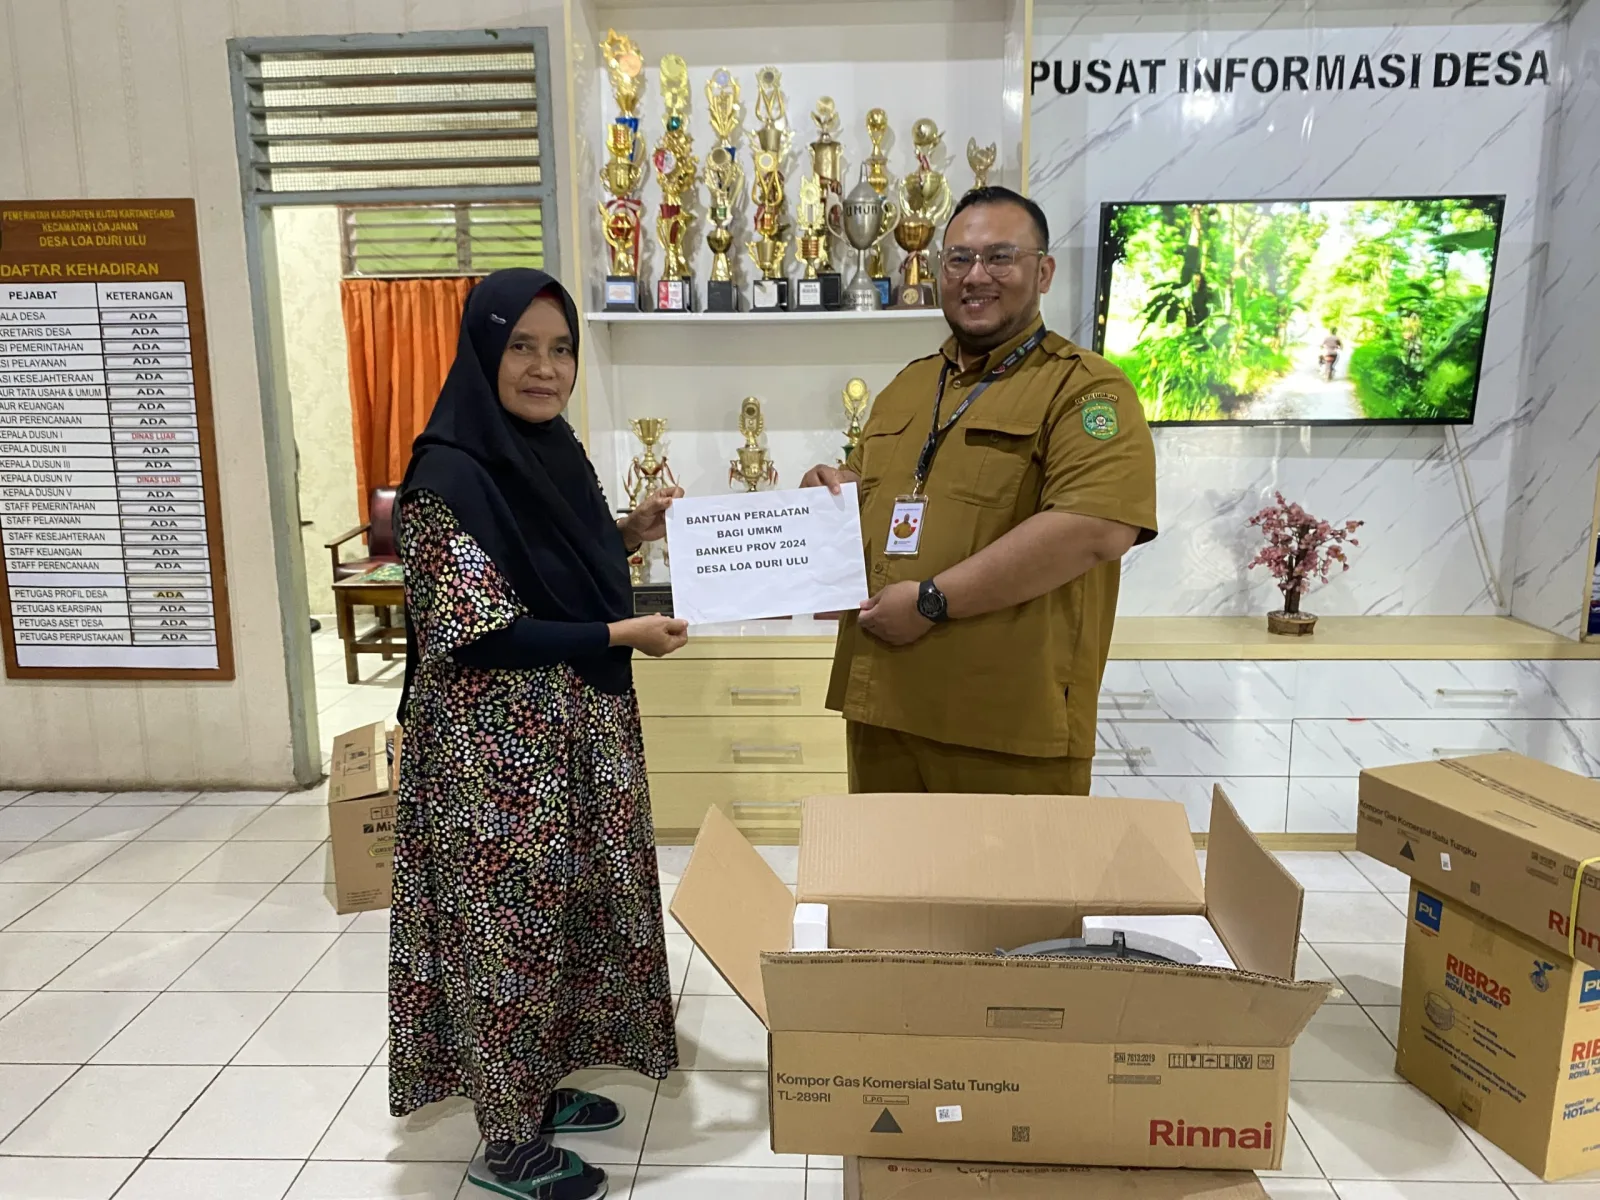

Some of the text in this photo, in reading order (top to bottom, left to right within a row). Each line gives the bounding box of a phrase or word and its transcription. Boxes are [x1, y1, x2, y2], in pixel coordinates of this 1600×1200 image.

[1031, 50, 1550, 96] PUSAT INFORMASI DESA
[51, 210, 93, 219] KABUPATEN
[42, 222, 138, 232] KECAMATAN LOA JANAN
[40, 235, 146, 247] DESA LOA DURI ULU
[0, 263, 159, 276] DAFTAR KEHADIRAN
[9, 291, 57, 300] PEJABAT
[106, 292, 173, 300] KETERANGAN
[20, 312, 46, 320] DESA
[45, 328, 71, 336] DESA
[10, 343, 84, 352] PEMERINTAHAN
[12, 359, 67, 367] PELAYANAN
[13, 374, 94, 383] KESEJAHTERAAN
[16, 388, 36, 397] TATA
[38, 388, 67, 396] USAHA
[68, 388, 74, 396] &
[76, 388, 101, 396] UMUM
[18, 402, 64, 410] KEUANGAN
[20, 416, 82, 424] PERENCANAAN
[29, 430, 58, 439] DUSUN
[0, 460, 31, 468] KEPALA
[32, 460, 61, 468] DUSUN
[1, 474, 32, 482] KEPALA
[34, 474, 62, 482] DUSUN
[3, 488, 72, 497] KEPALA DUSUN V
[5, 502, 96, 511] STAFF PEMERINTAHAN
[34, 516, 81, 524] PELAYANAN
[686, 506, 810, 525] BANTUAN PERALATAN
[716, 525, 782, 538] BAGI UMKM
[8, 533, 105, 541] STAFF KESEJAHTERAAN
[10, 548, 82, 556] STAFF KEUANGAN
[696, 539, 806, 557] BANKEU PROV 2024
[696, 556, 809, 574] DESA LOA DURI ULU
[55, 590, 84, 598] PROFIL
[19, 619, 57, 627] PETUGAS
[58, 619, 79, 627] ASET
[60, 633, 124, 641] PERPUSTAKAAN
[1360, 799, 1384, 815] Kompor
[1384, 809, 1397, 822] Gas
[1398, 816, 1432, 836] Komersial
[1432, 830, 1448, 845] Satu
[1450, 839, 1477, 858] Tungku
[1419, 902, 1437, 920] PL
[1446, 953, 1511, 1006] RIBR26
[776, 1073, 1020, 1093] Kompor Gas Komersial Satu Tungku
[778, 1090, 831, 1102] TL-289RI
[1150, 1119, 1272, 1149] Rinnai
